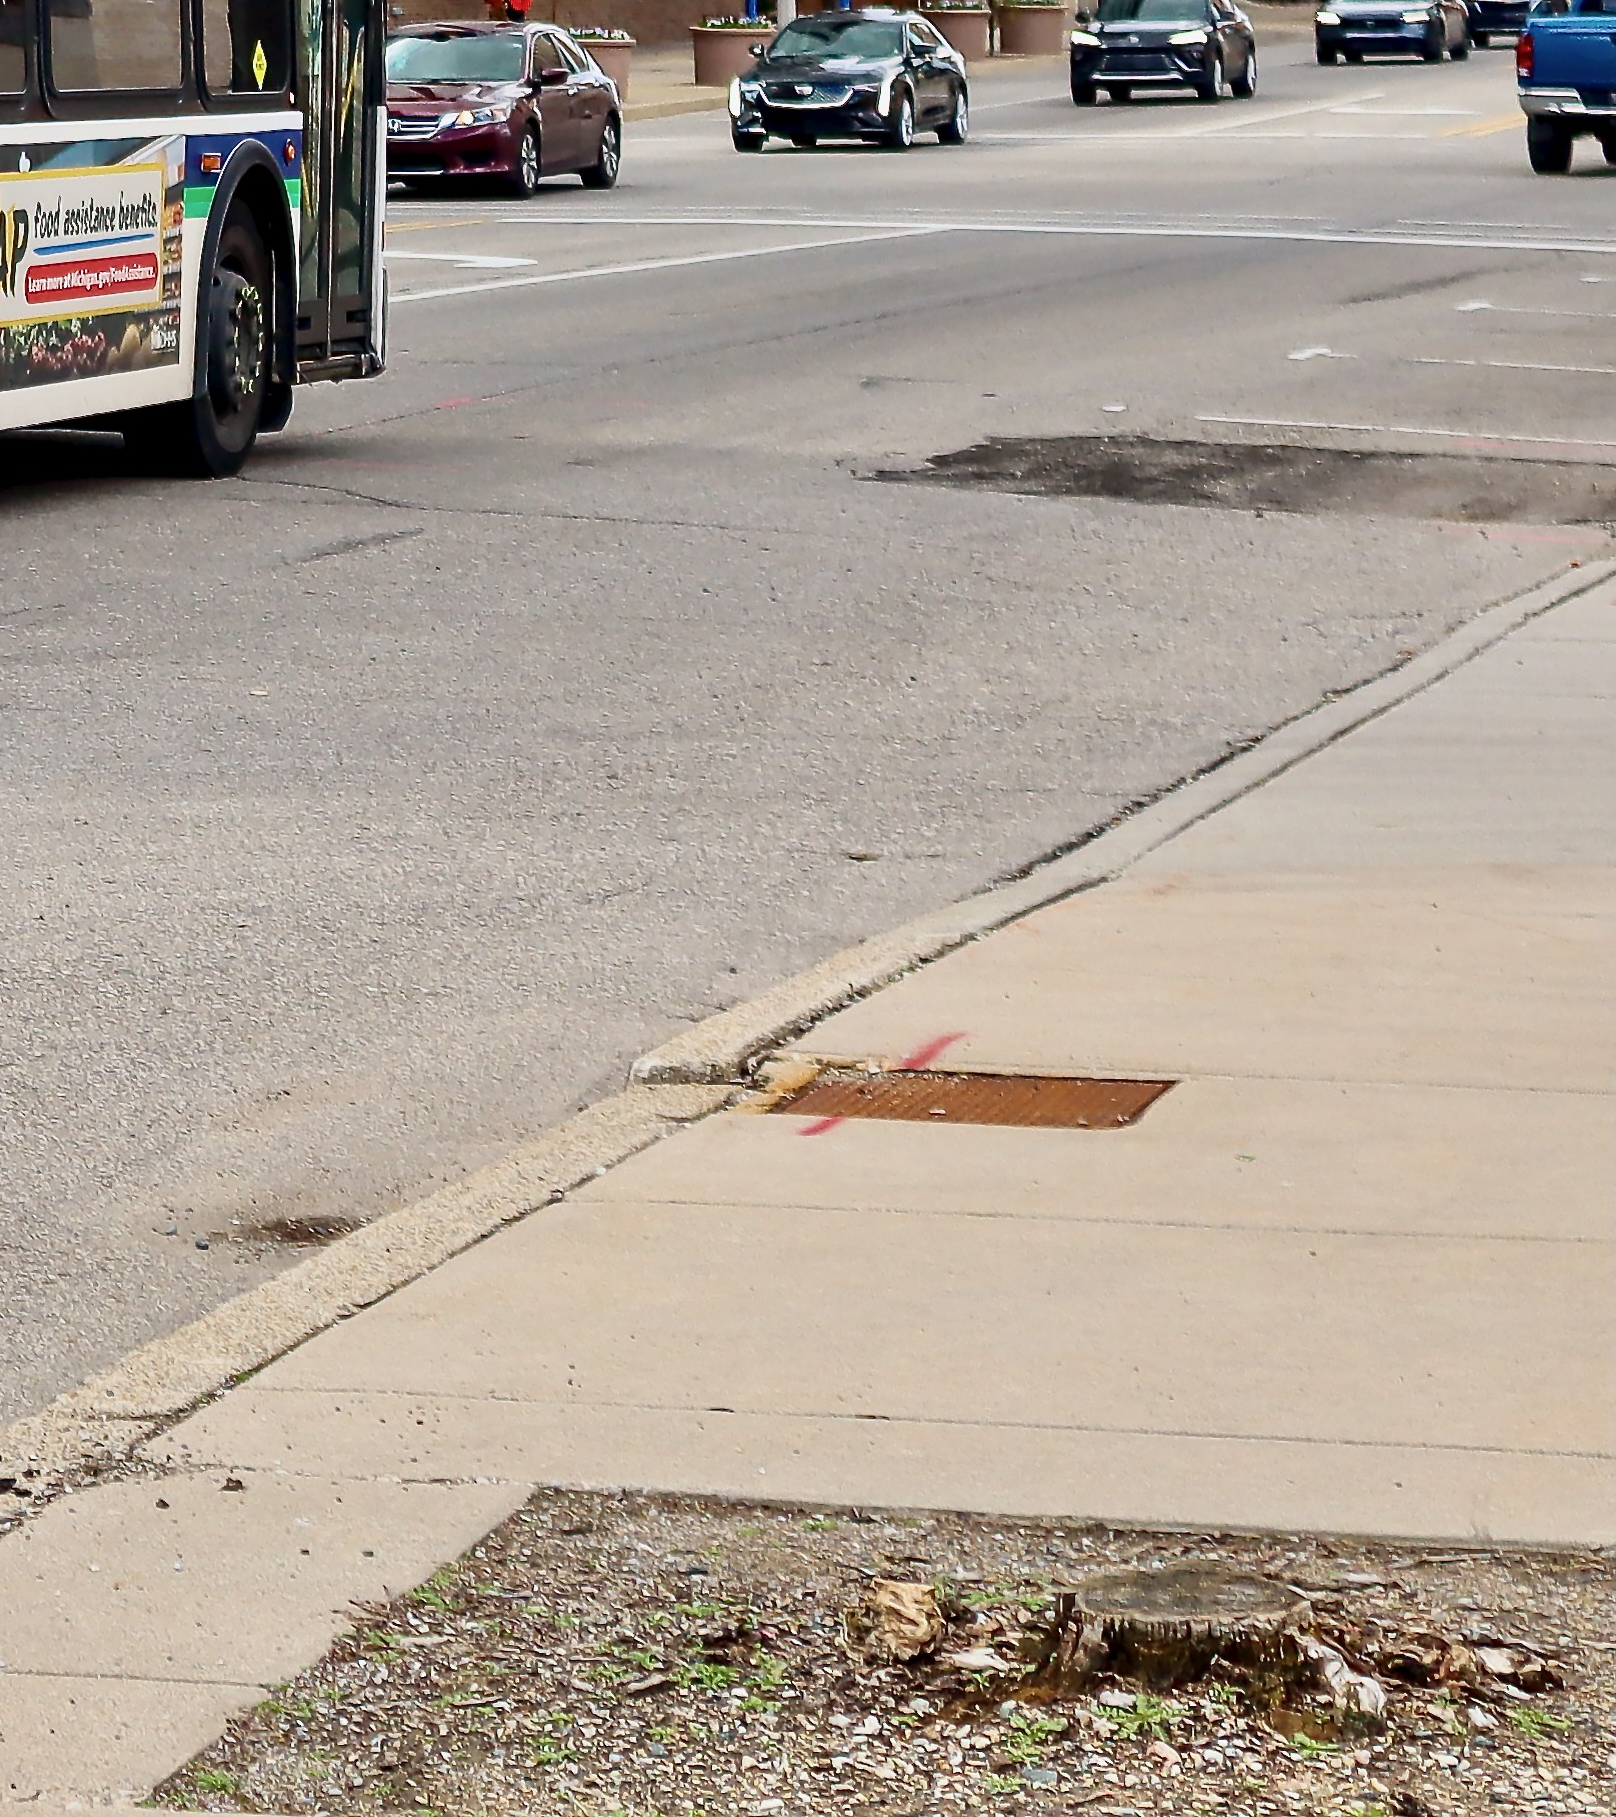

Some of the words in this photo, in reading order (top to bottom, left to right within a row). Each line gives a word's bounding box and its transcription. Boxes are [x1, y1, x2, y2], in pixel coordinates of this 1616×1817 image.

[34, 195, 62, 239] food
[63, 197, 116, 235] assistance
[119, 190, 158, 231] benefits.
[28, 276, 47, 293] Learn
